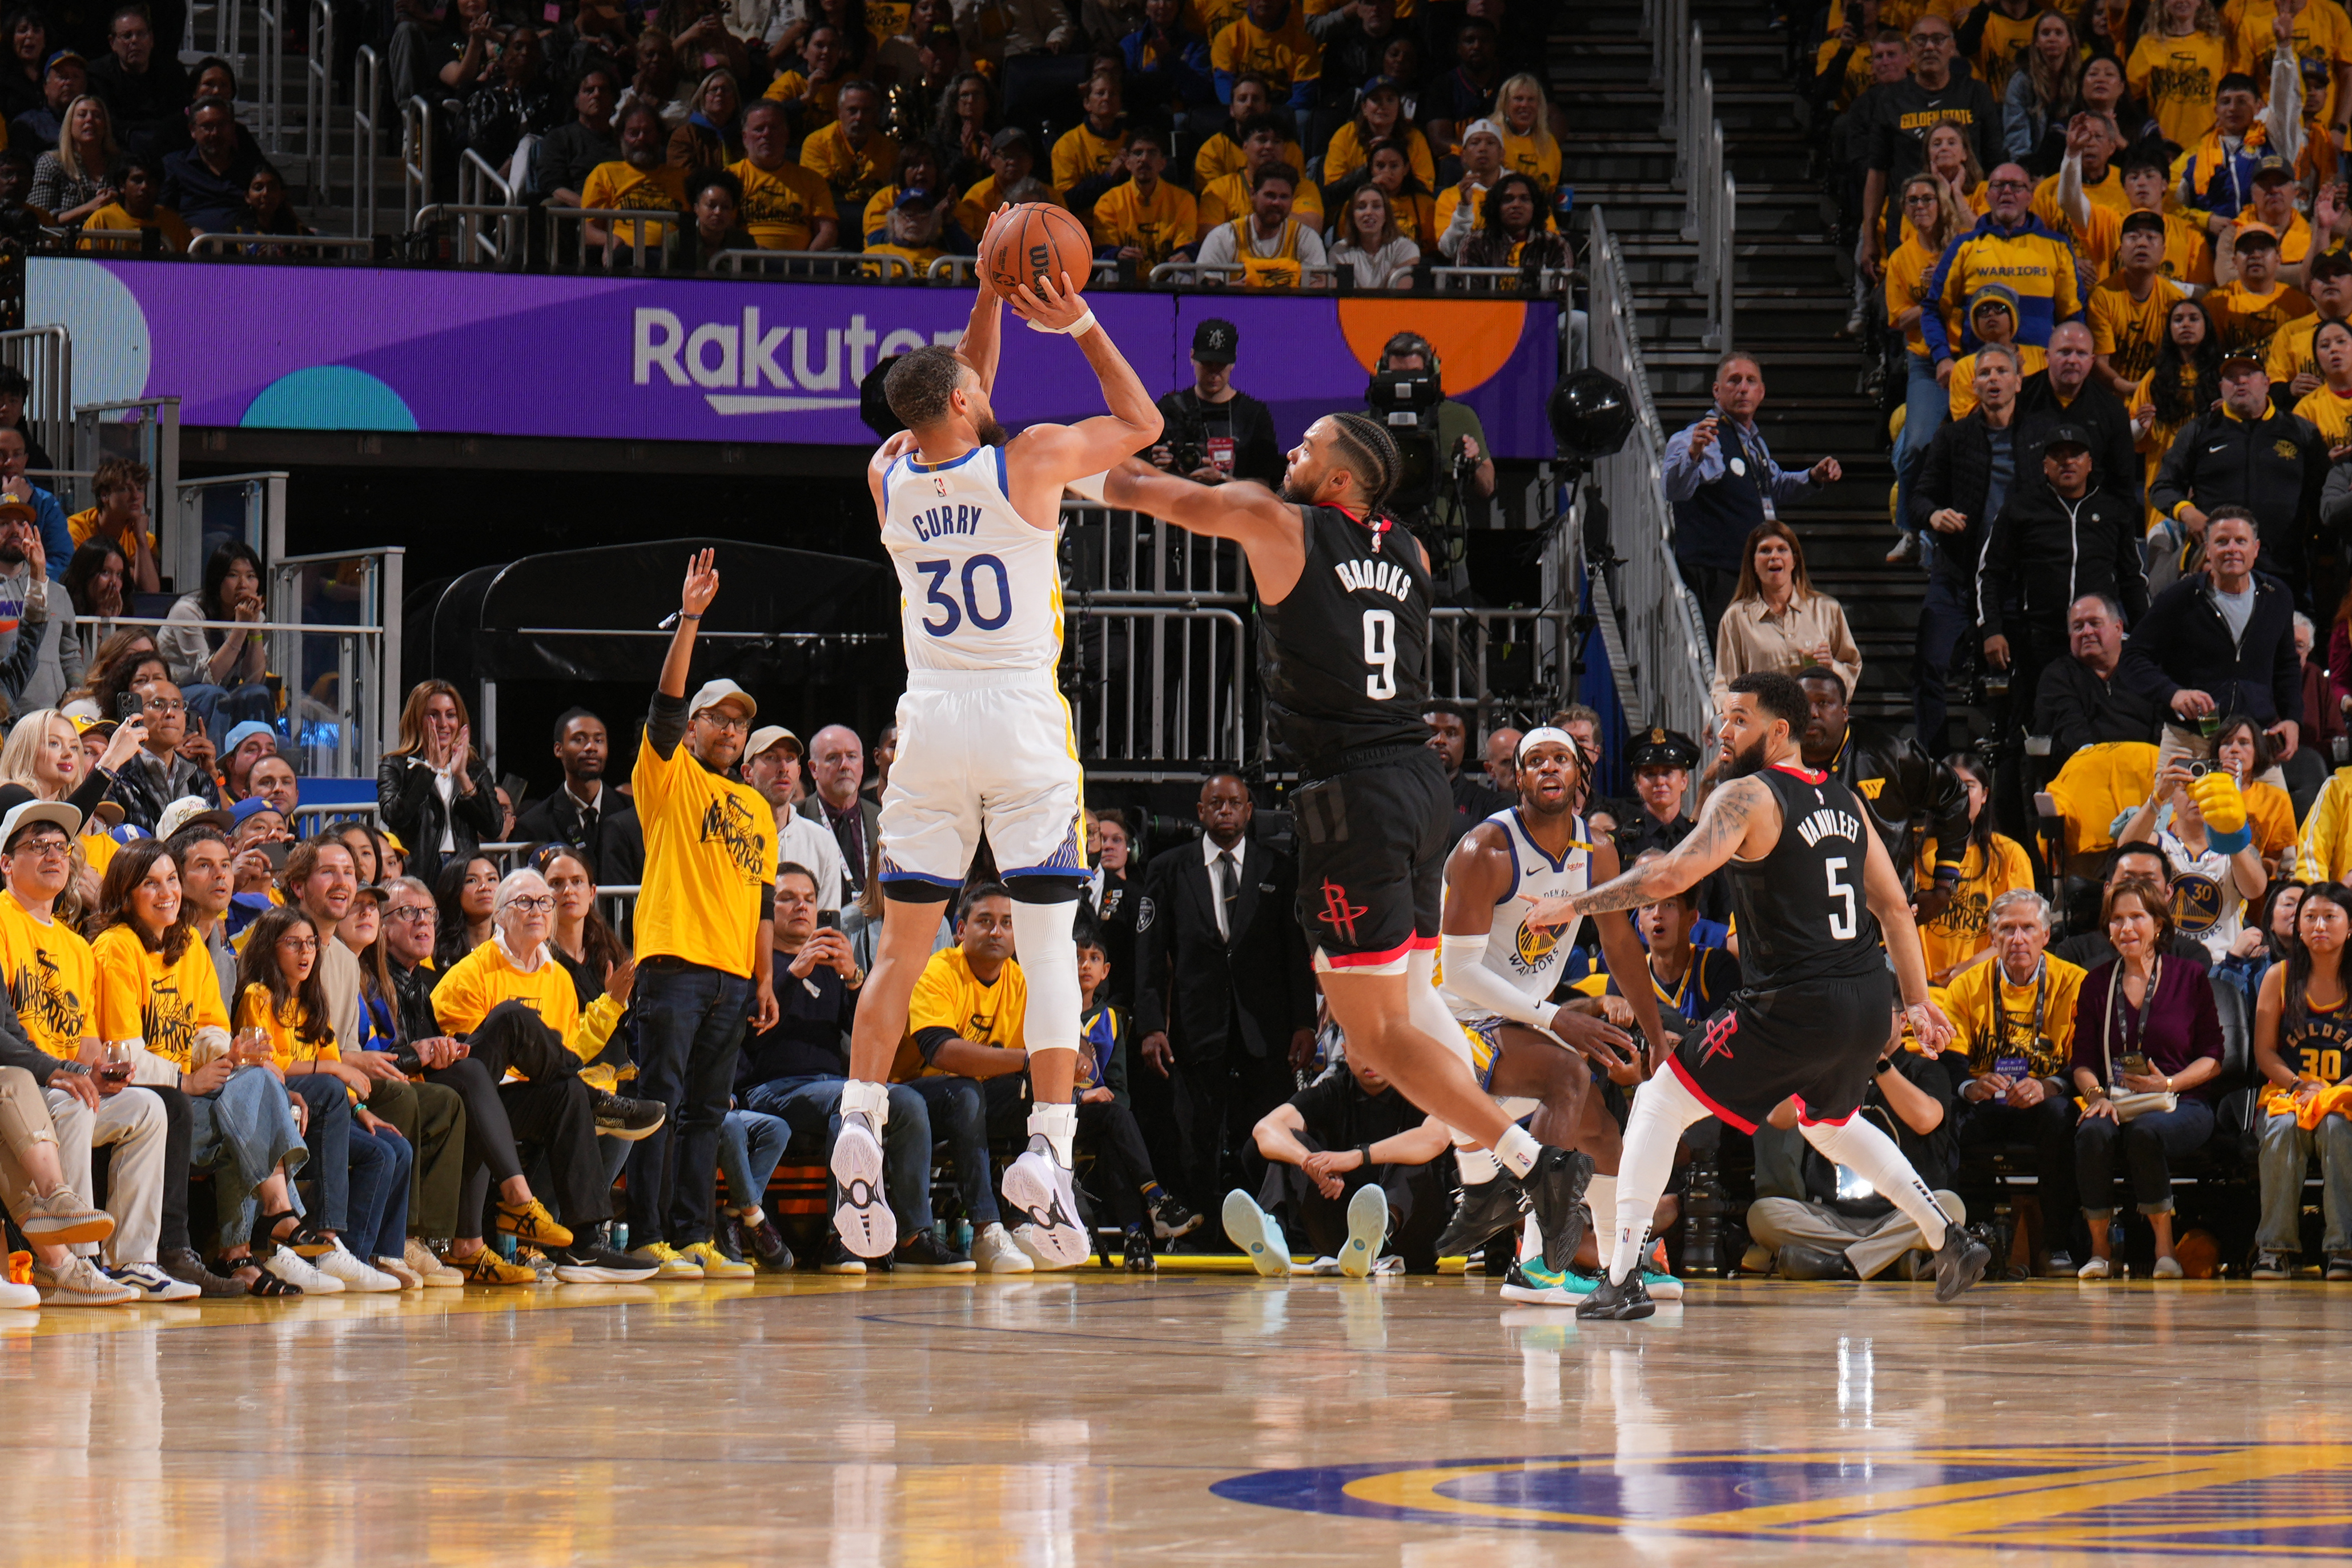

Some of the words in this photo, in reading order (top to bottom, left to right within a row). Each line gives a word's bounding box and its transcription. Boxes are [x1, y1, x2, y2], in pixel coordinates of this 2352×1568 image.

[1976, 266, 2048, 276] WARRIORS
[912, 505, 982, 541] CURRY
[915, 553, 1012, 637] 30
[1334, 559, 1412, 601] BROOKS
[1363, 609, 1396, 699] 9
[1798, 809, 1859, 847] VANVLEET
[1826, 857, 1856, 939] 5
[2193, 883, 2212, 902] 30
[2298, 1048, 2341, 1080] 30
[595, 1117, 625, 1128] HOKA
